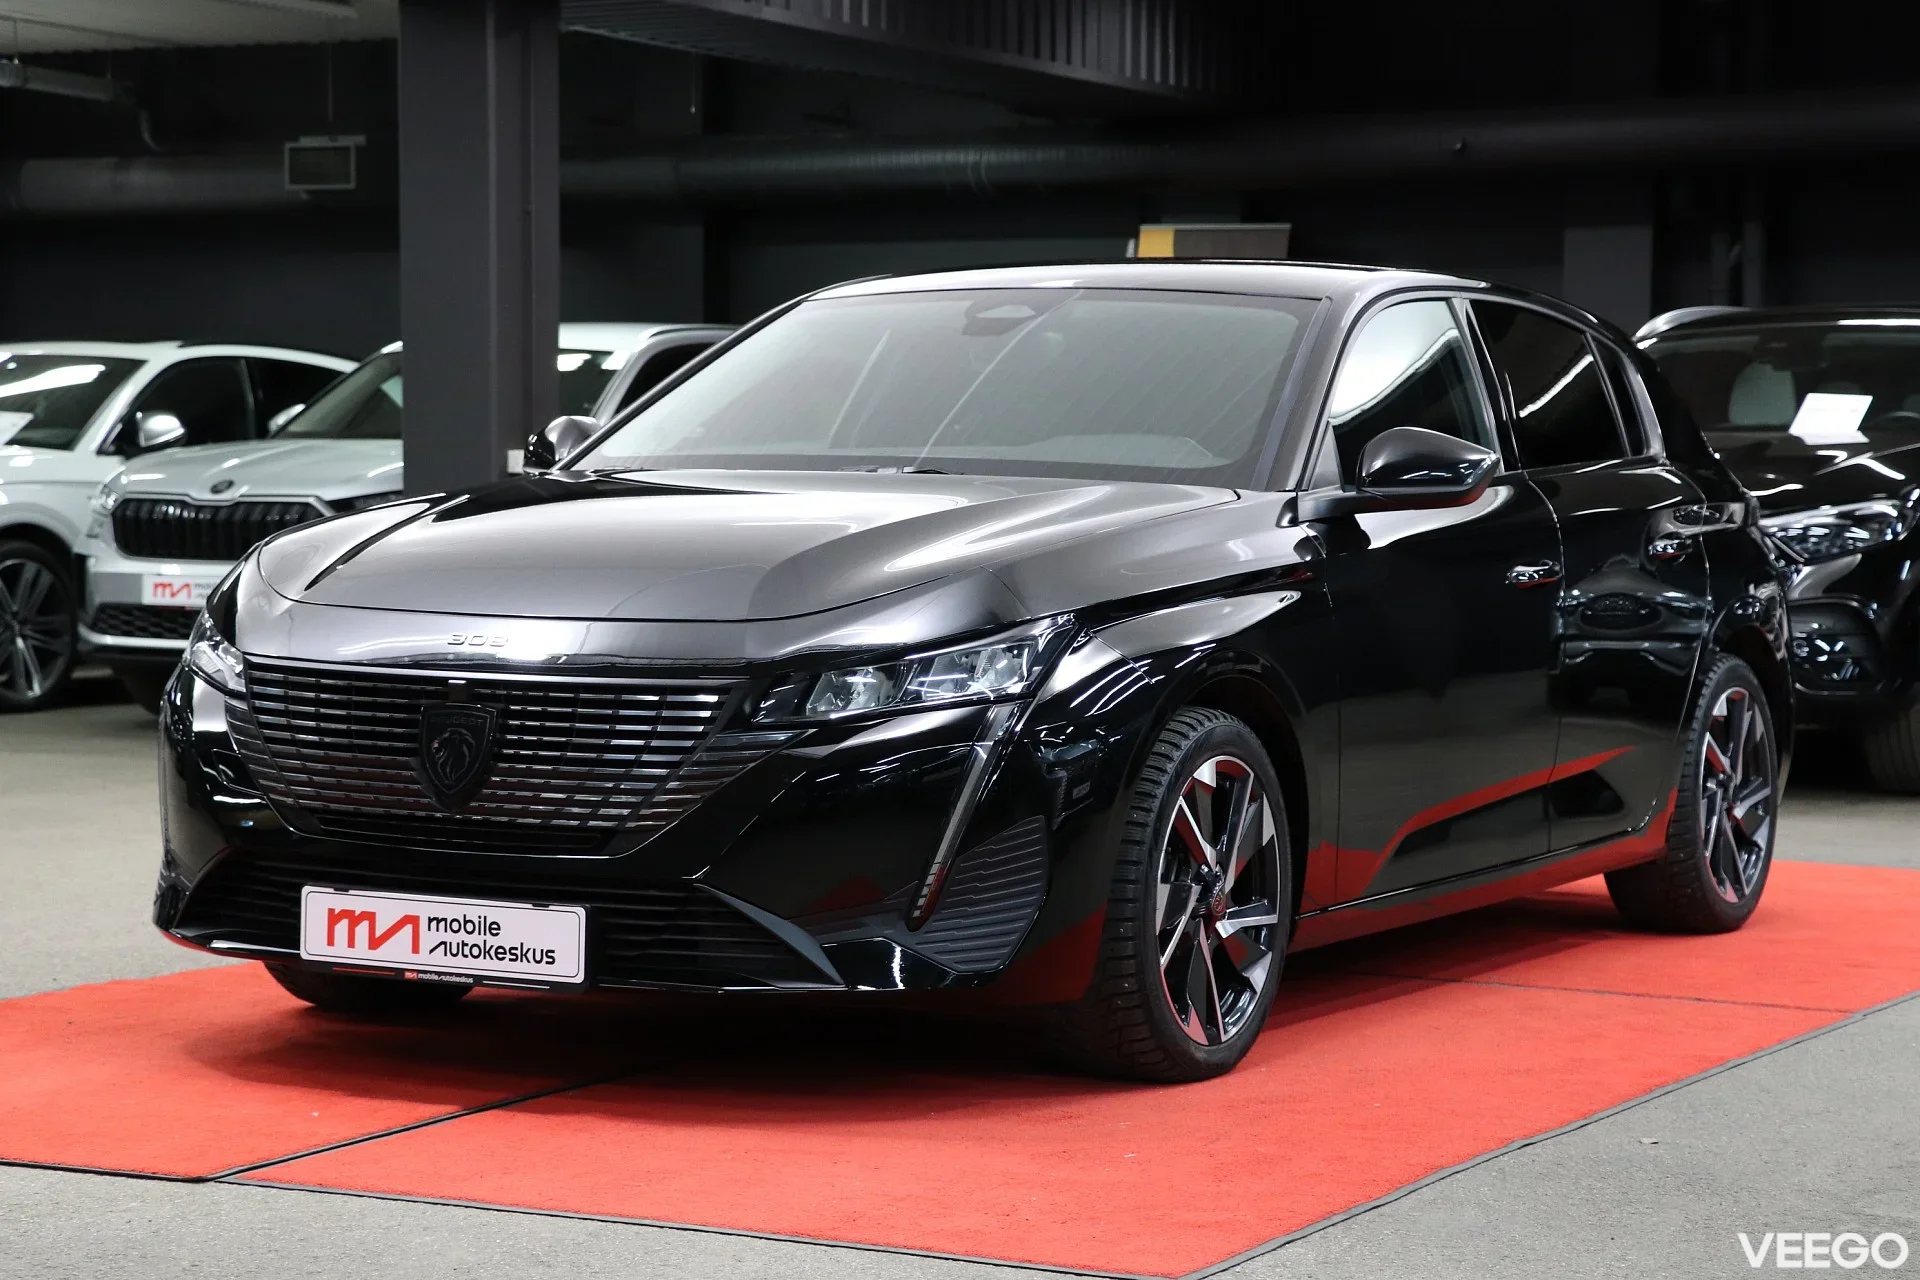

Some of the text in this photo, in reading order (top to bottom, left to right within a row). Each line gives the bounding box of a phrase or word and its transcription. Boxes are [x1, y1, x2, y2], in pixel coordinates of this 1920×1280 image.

[447, 633, 509, 647] 308
[429, 715, 483, 725] UGEOT
[427, 914, 501, 936] mobile
